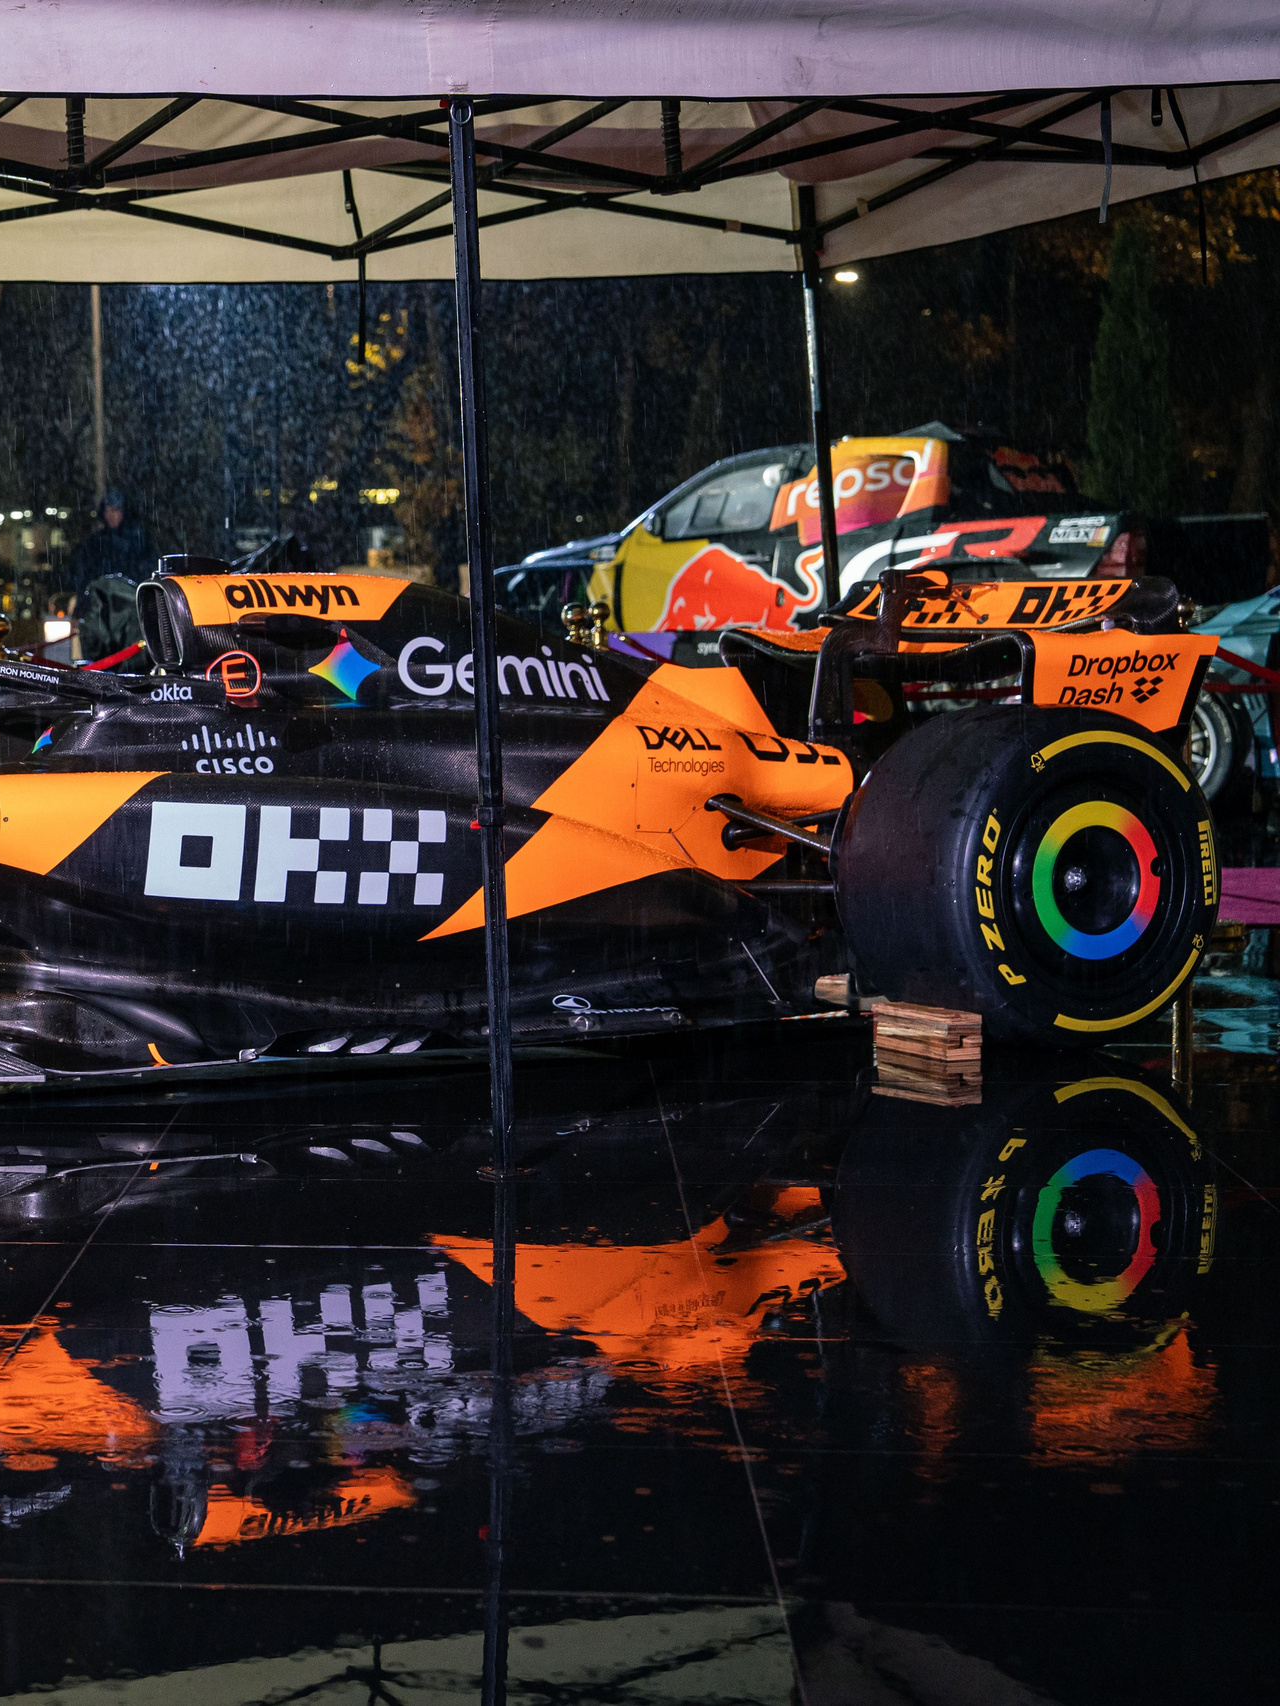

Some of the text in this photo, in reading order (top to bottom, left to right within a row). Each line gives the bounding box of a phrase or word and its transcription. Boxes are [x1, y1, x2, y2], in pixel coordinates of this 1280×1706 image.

[226, 580, 360, 614] allwyn
[19, 670, 59, 684] MOUNTAIN
[1067, 650, 1180, 679] Dropbox
[150, 683, 193, 701] okta
[1058, 682, 1124, 705] Dash
[635, 725, 722, 751] DELL
[648, 757, 725, 776] Technologies
[1197, 819, 1218, 906] PIRELLI
[975, 814, 1027, 986] P ZERO
